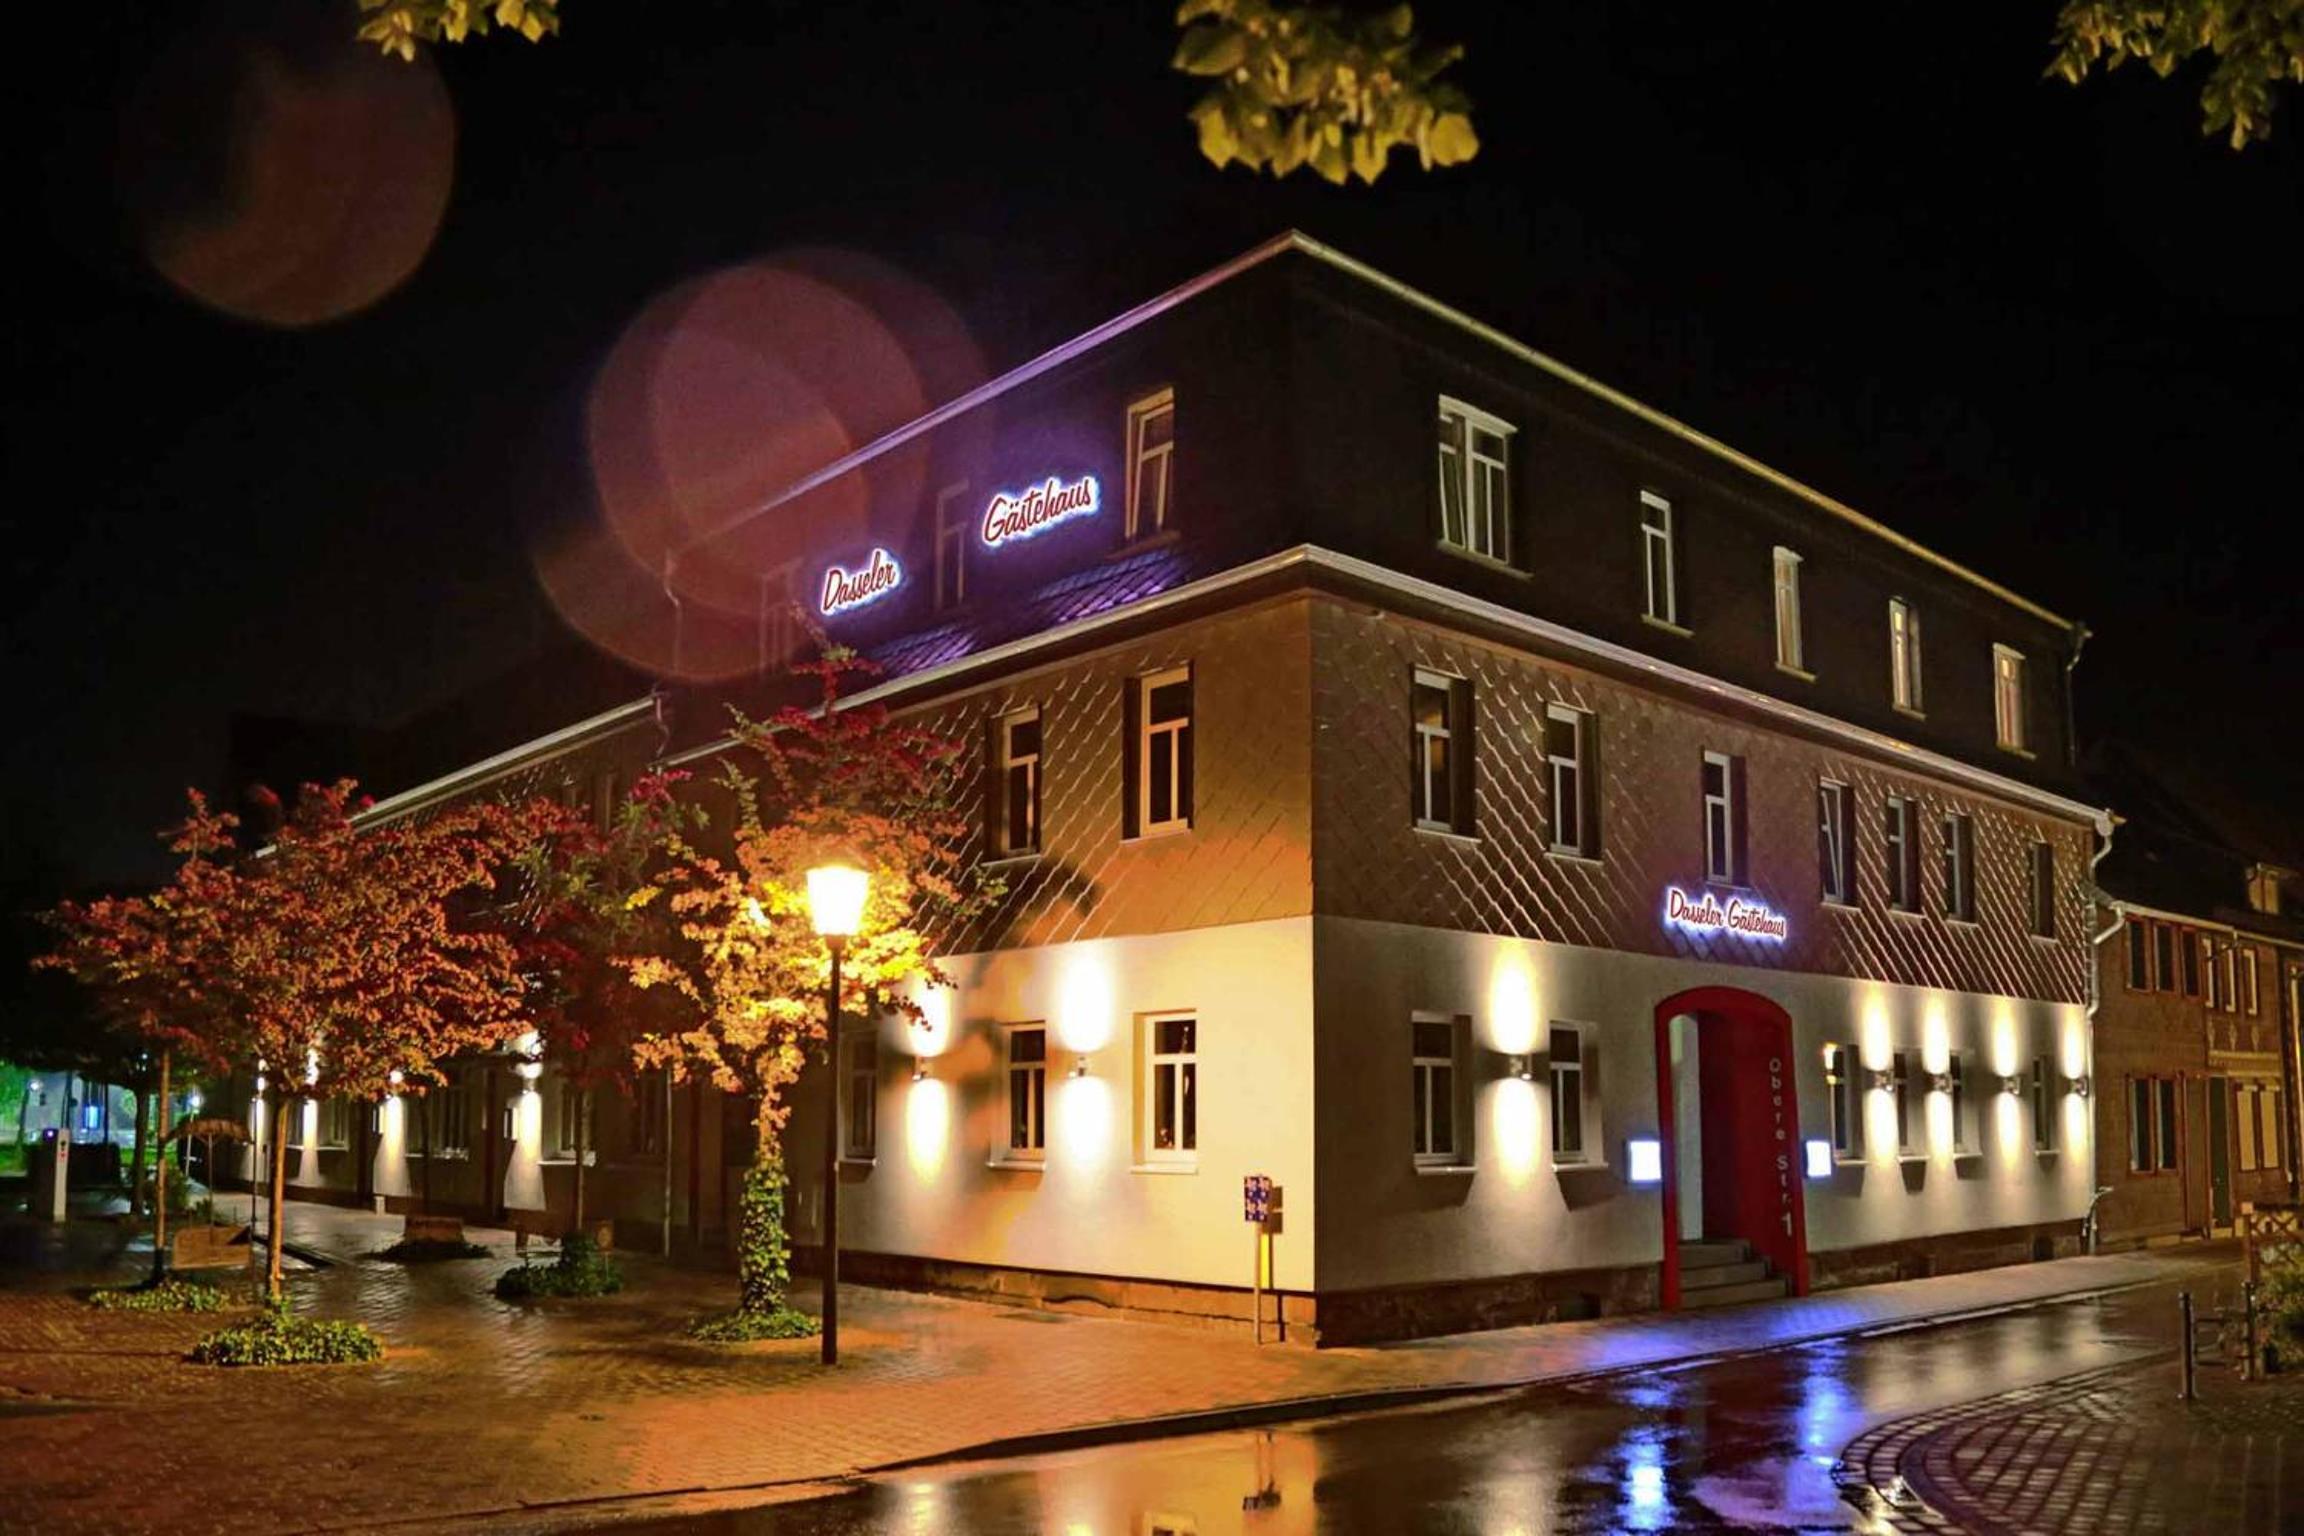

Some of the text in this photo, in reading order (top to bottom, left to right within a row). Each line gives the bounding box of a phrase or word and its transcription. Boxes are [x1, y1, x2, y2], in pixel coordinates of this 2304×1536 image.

[821, 479, 1092, 612] Dasseler Gästehaus
[1670, 889, 1785, 937] Dasseler Gästehaus
[1769, 1057, 1786, 1140] Obere
[1781, 1212, 1793, 1237] 1
